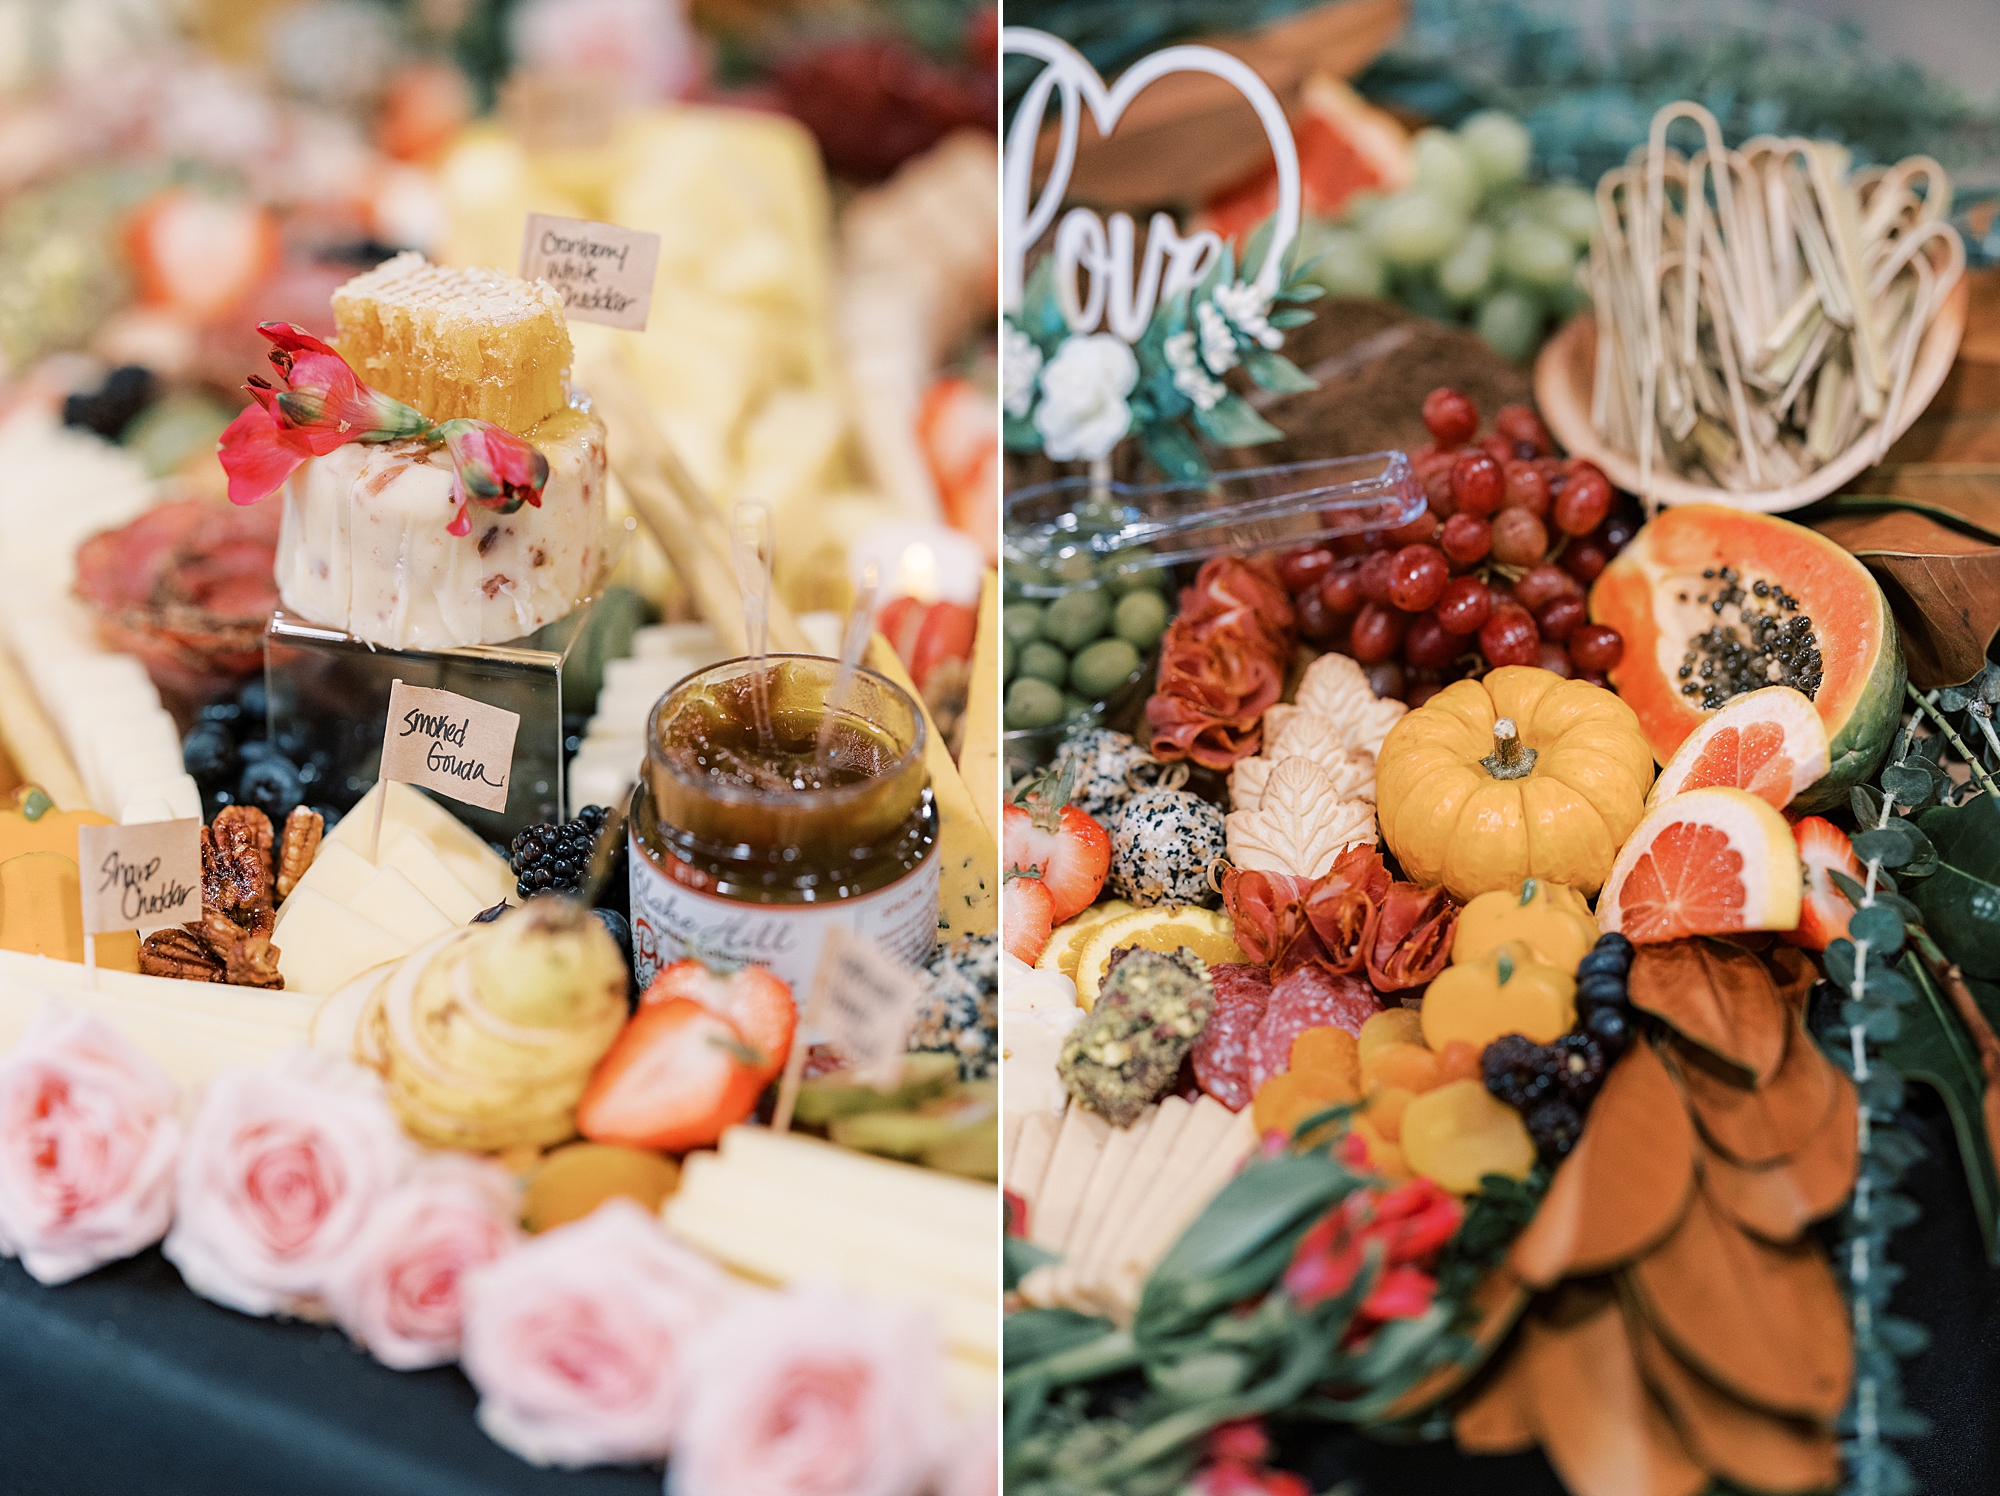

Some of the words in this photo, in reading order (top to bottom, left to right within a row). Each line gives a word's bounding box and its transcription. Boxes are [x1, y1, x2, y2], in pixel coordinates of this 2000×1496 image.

[1003, 62, 1223, 342] love
[540, 230, 630, 272] Cranberry
[400, 708, 469, 748] Smoked
[427, 741, 505, 787] Gouda
[99, 850, 162, 894] Sharp
[121, 878, 196, 921] Cheddar
